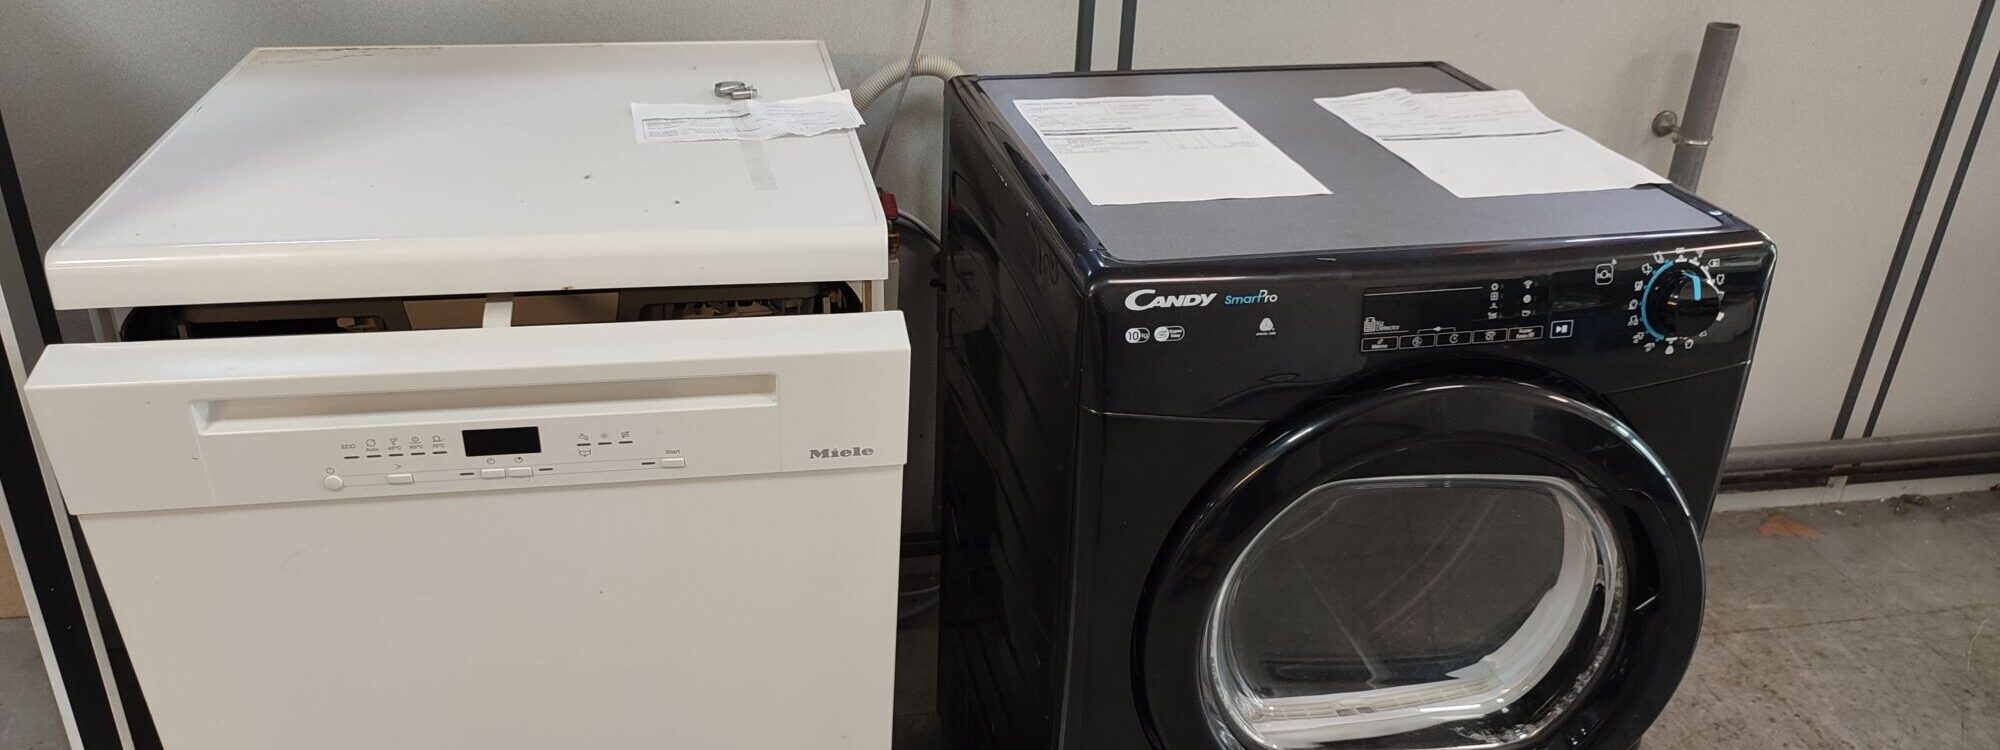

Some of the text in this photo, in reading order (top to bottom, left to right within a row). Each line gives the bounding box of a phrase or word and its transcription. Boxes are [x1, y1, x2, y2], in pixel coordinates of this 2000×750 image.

[1124, 288, 1217, 311] CANDY
[1128, 331, 1139, 341] 10
[809, 446, 874, 460] Miele
